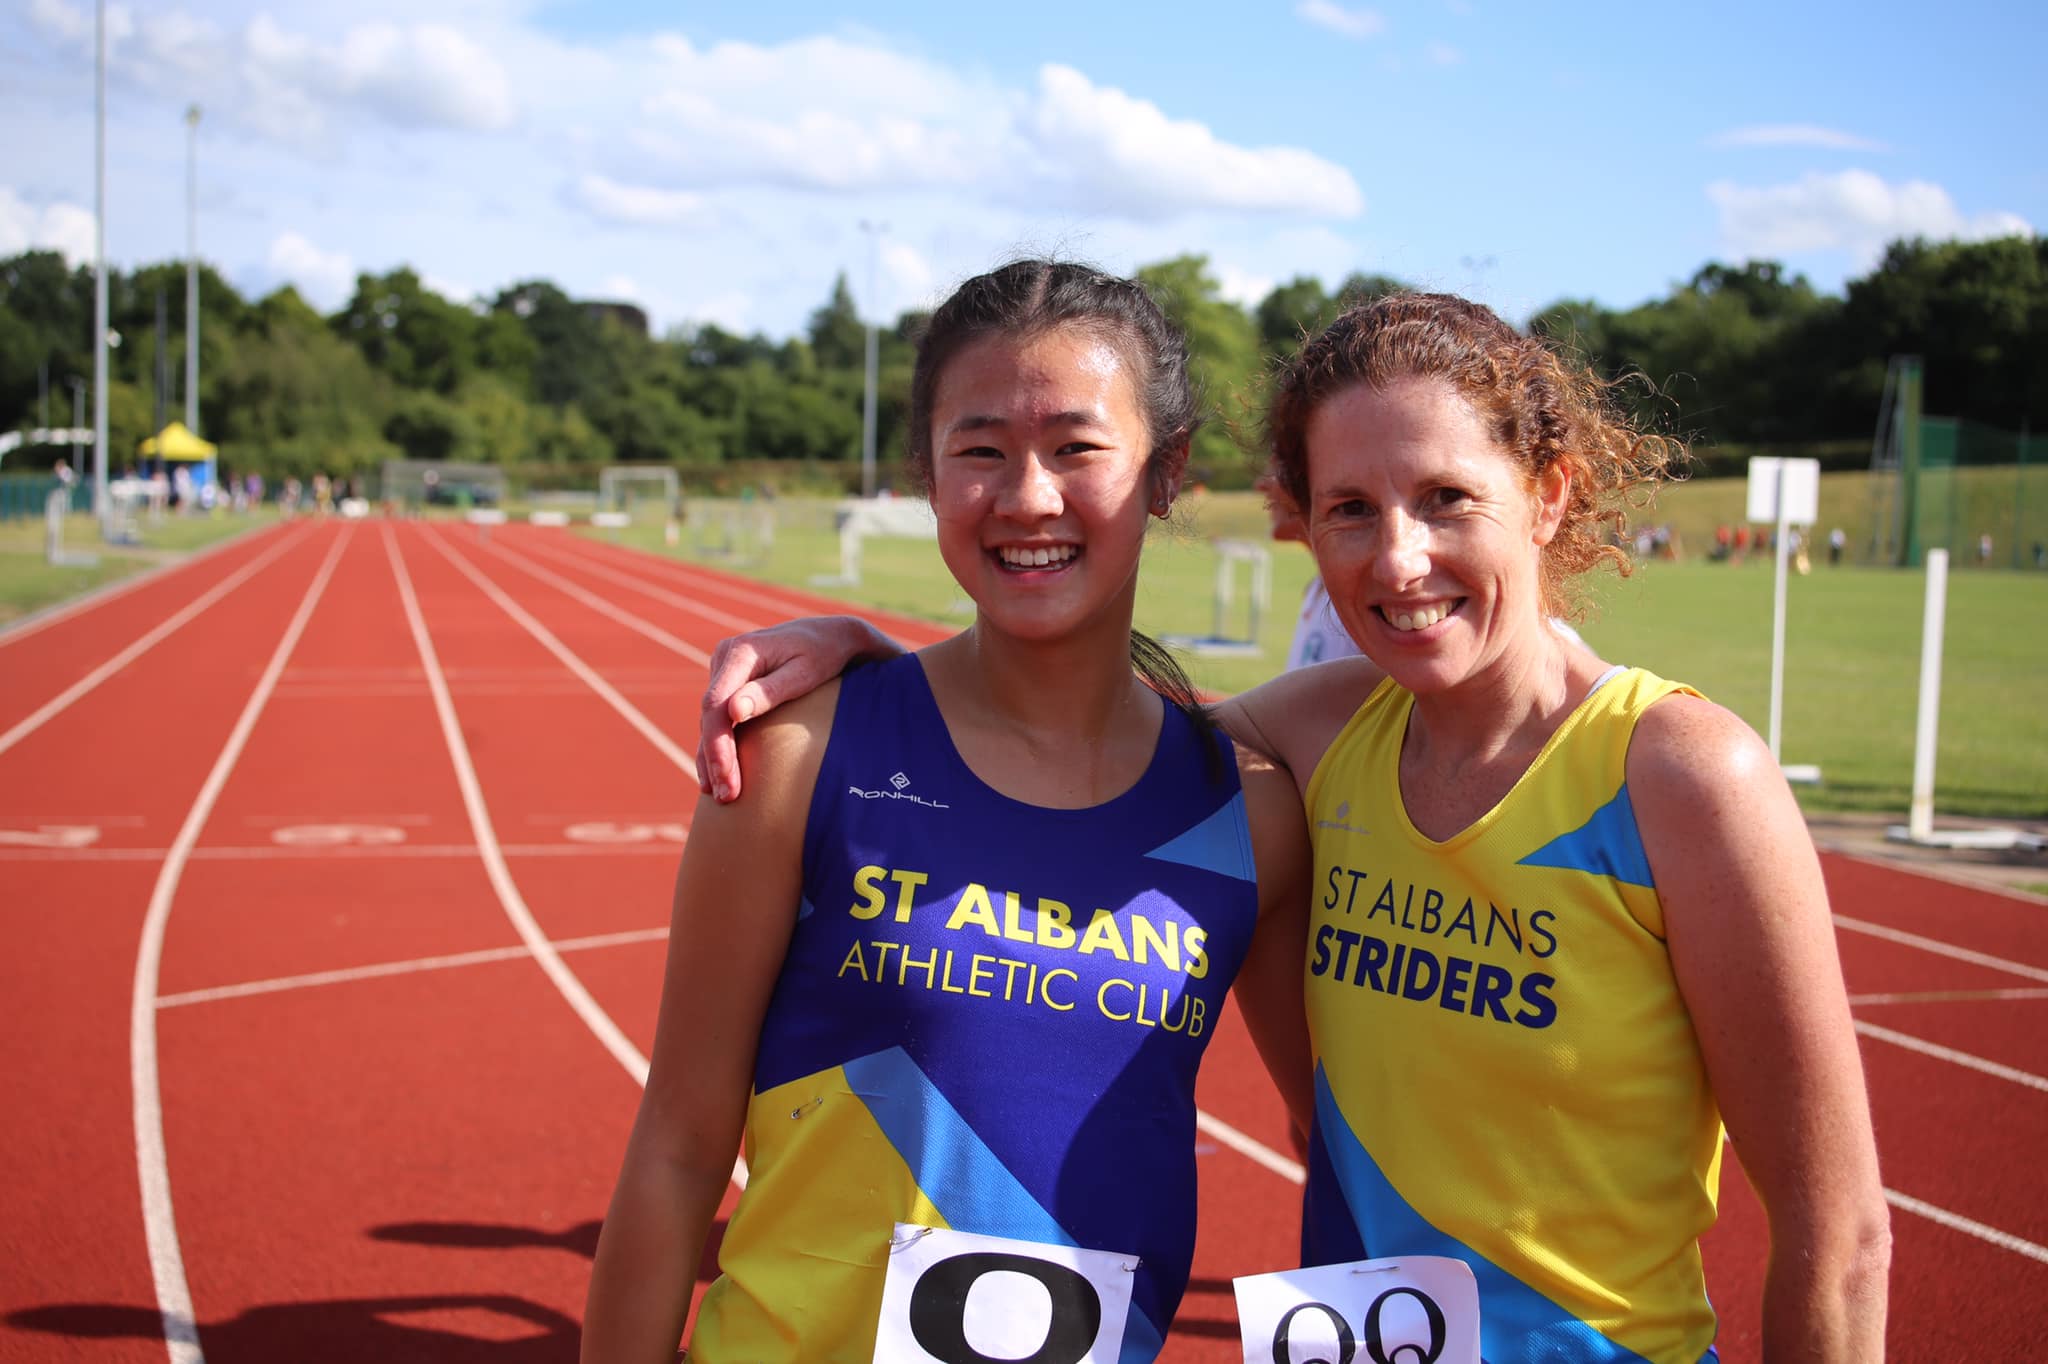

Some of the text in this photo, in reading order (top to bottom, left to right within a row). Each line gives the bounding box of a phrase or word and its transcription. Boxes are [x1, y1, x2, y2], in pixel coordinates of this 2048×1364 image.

[849, 786, 949, 808] RONHILL
[848, 865, 1209, 979] ST ALBANS
[1324, 866, 1557, 958] ST ALBANS
[837, 939, 1207, 1038] ATHLETIC CLUB
[1311, 924, 1557, 1029] STRIDERS
